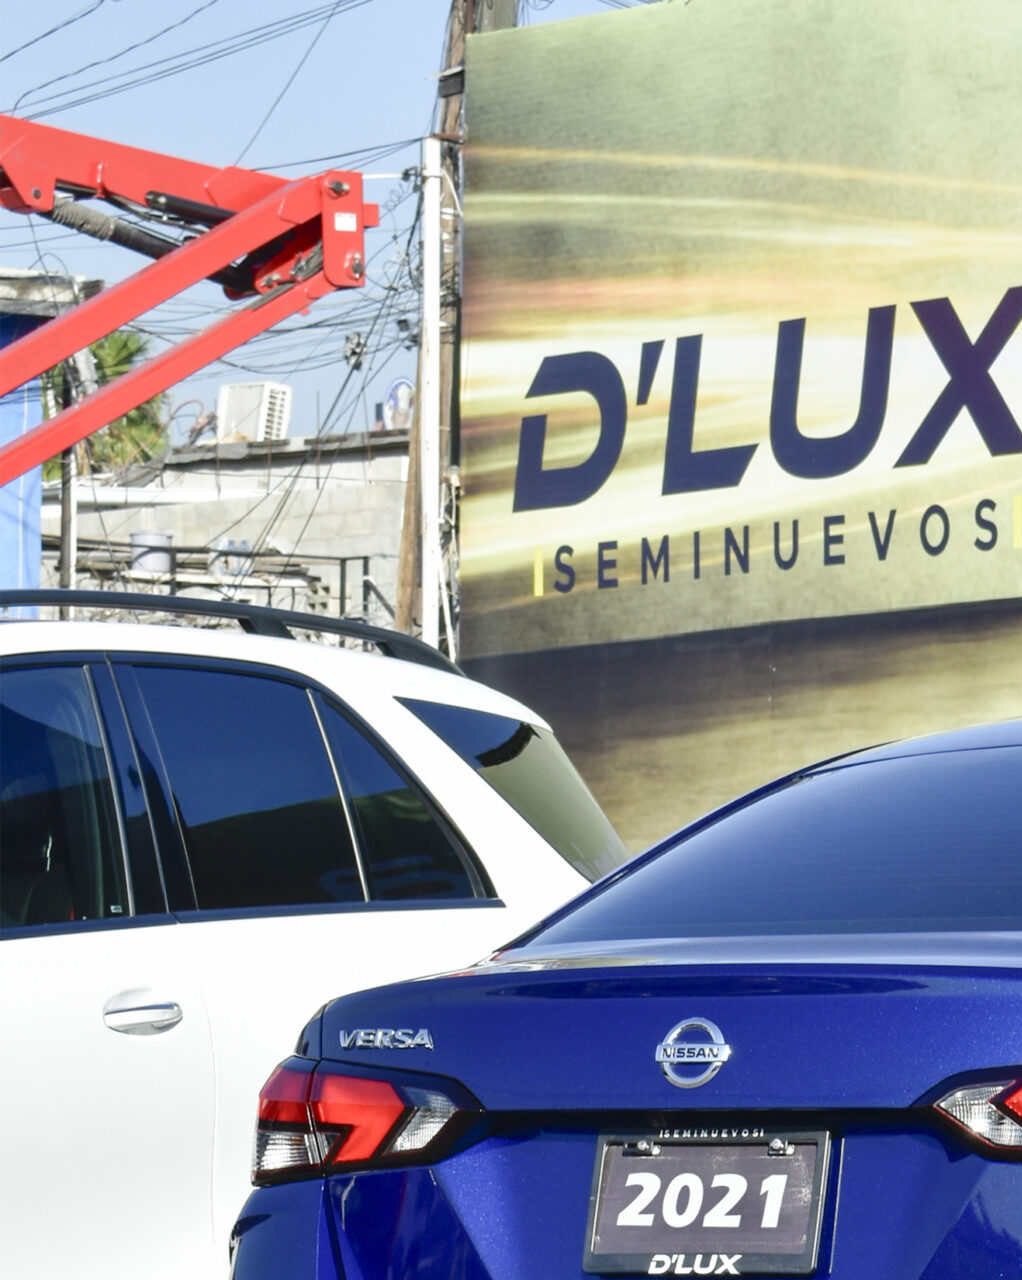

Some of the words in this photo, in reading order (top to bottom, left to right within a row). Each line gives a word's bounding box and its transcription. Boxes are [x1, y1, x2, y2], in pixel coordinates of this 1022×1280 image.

[553, 498, 999, 594] SEMINUEVOS
[338, 1027, 435, 1051] VERSA
[661, 1046, 719, 1059] NISSAN
[616, 1172, 789, 1229] 2021
[648, 1254, 744, 1275] D'LUX
